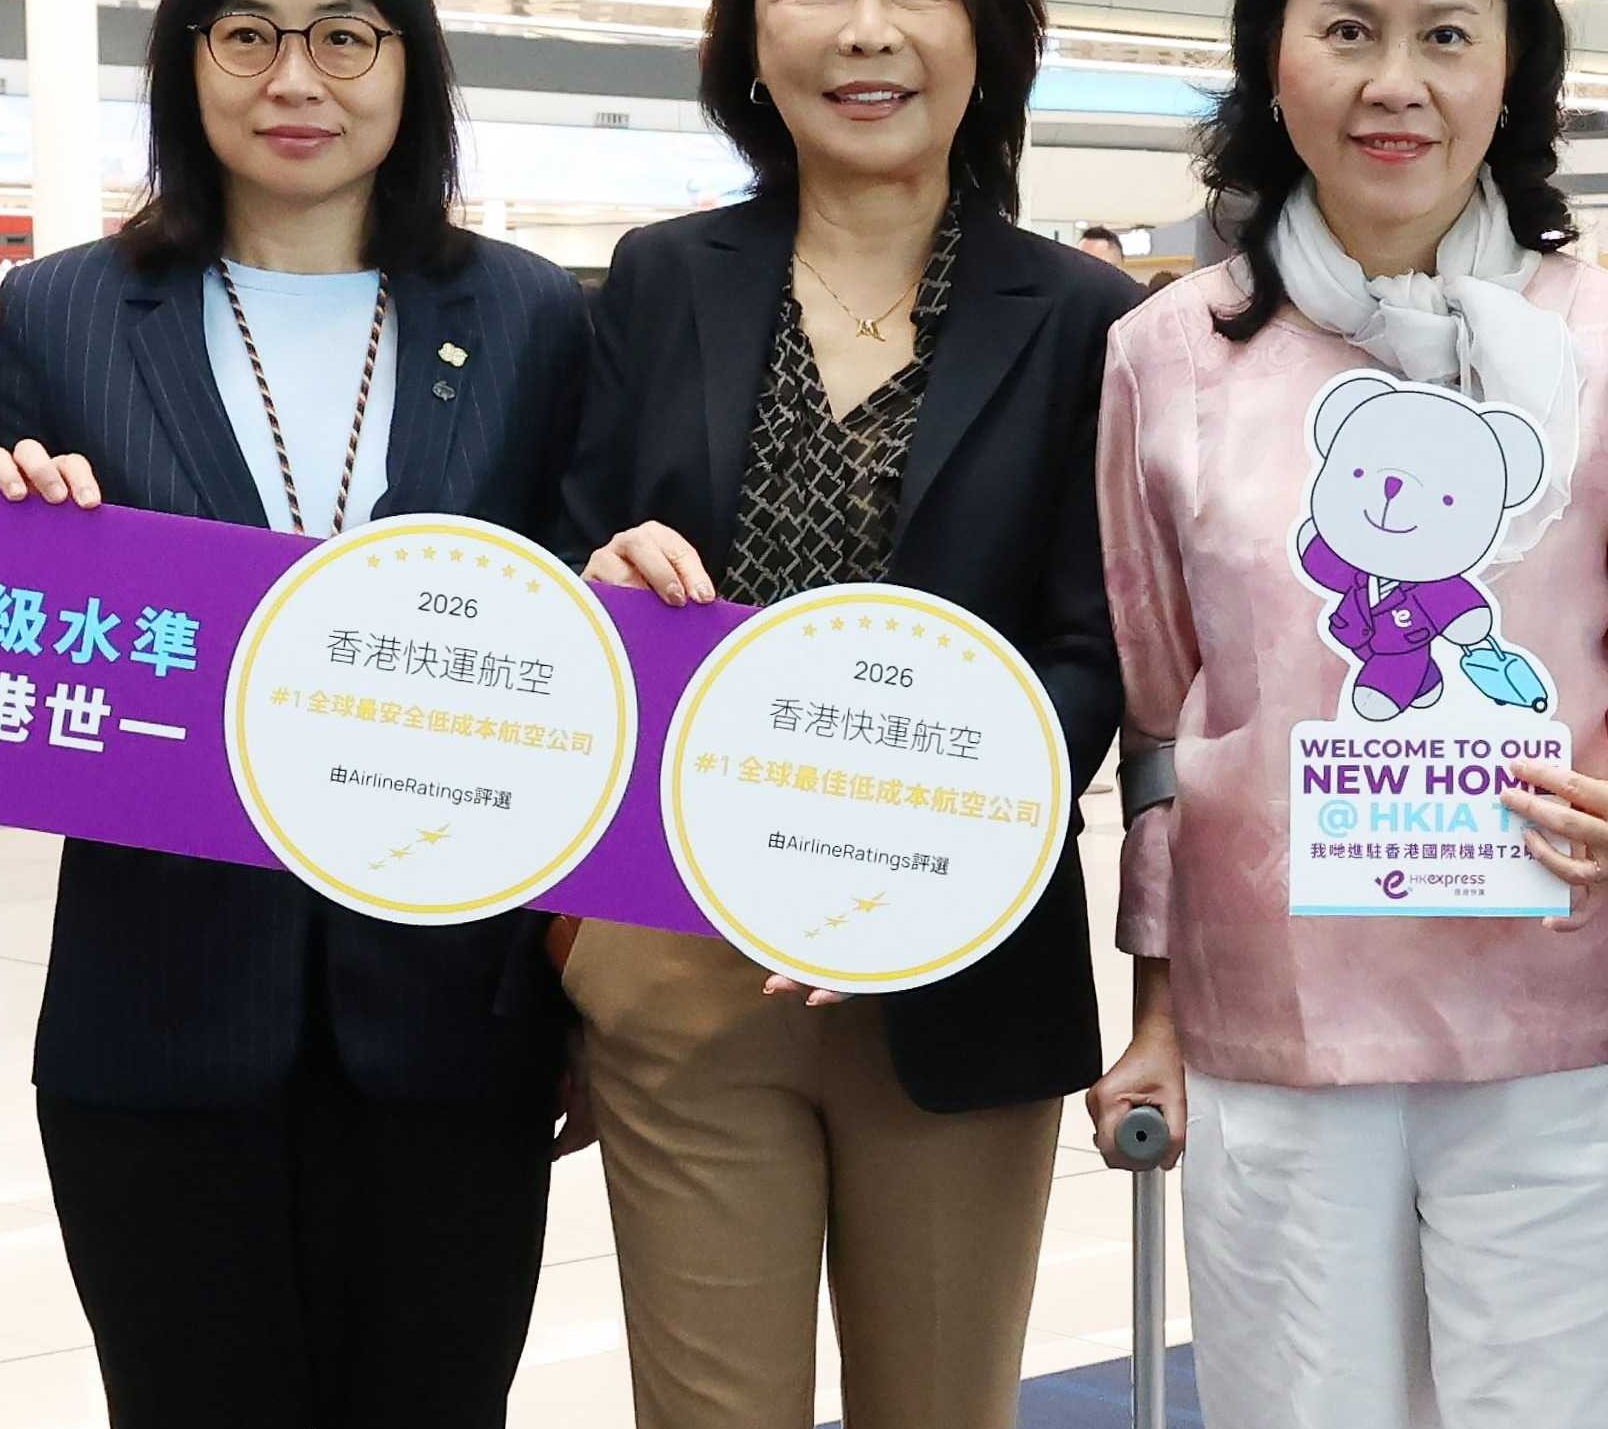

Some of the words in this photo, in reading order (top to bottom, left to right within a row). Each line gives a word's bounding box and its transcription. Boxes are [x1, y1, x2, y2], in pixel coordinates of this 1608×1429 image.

[418, 592, 477, 618] 2026
[328, 630, 553, 695] 香港快運航空
[854, 661, 912, 687] 2026
[310, 690, 592, 754] 全球最安全低成本航空公司
[770, 699, 981, 760] 香港快運航空
[1301, 739, 1444, 758] WELCOME
[1454, 740, 1491, 758] TO
[1501, 740, 1561, 758] OUR
[330, 765, 511, 809] 由AirlineRatings評選
[739, 756, 1040, 826] 全球最佳低成本航空公司
[1304, 765, 1409, 794] NEW
[1426, 765, 1556, 795] HOM
[1371, 802, 1477, 832] HKIA
[768, 831, 949, 875] 由AirlineRatings評選
[1410, 874, 1486, 887] HKexpress
